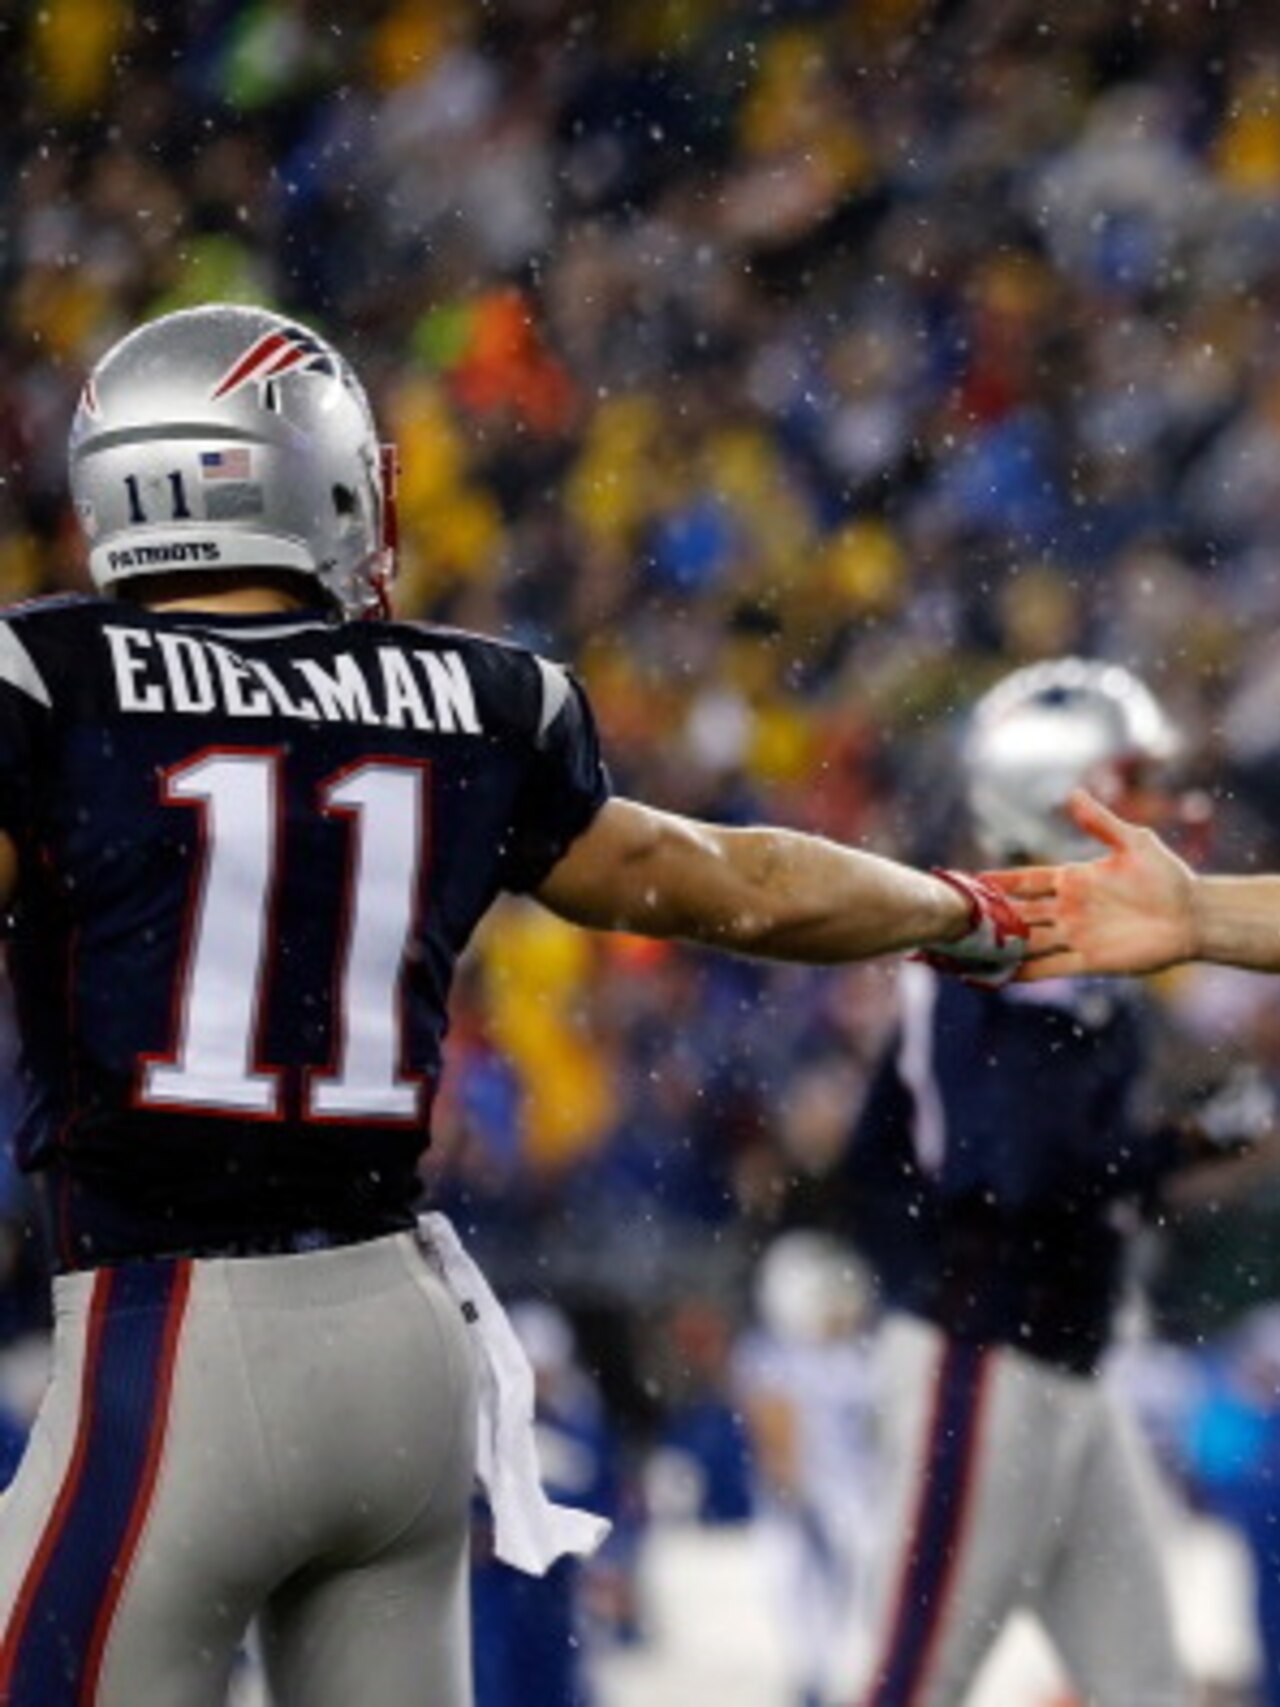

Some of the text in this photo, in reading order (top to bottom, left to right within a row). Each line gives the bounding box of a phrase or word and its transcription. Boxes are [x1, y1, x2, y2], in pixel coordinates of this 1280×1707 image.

[124, 469, 191, 524] 11
[108, 541, 221, 571] PATRIOTS
[102, 624, 483, 735] EDELMAN
[134, 743, 431, 1128] 11
